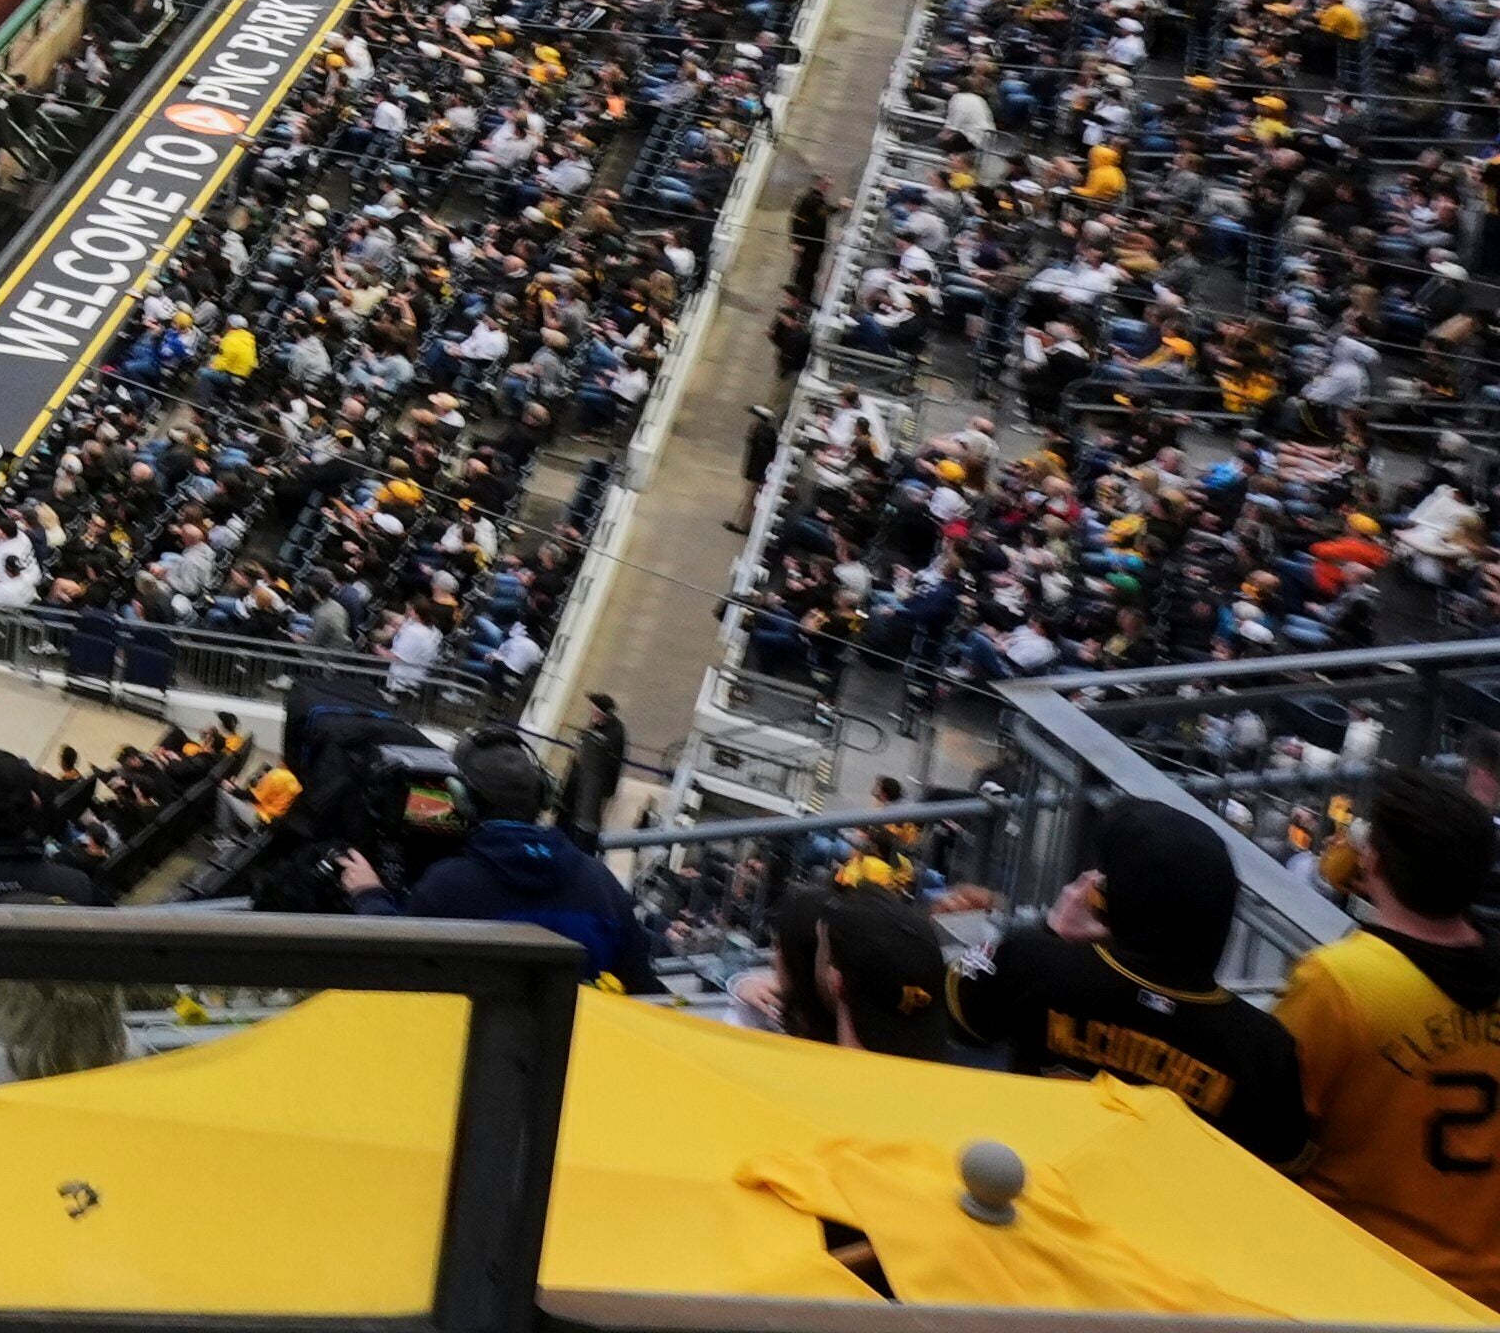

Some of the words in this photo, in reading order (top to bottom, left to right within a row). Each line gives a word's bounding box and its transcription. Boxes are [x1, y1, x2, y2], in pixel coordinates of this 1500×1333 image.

[139, 134, 219, 181] TO
[188, 47, 283, 116] PNC
[1046, 1008, 1236, 1117] McCUTCHEN
